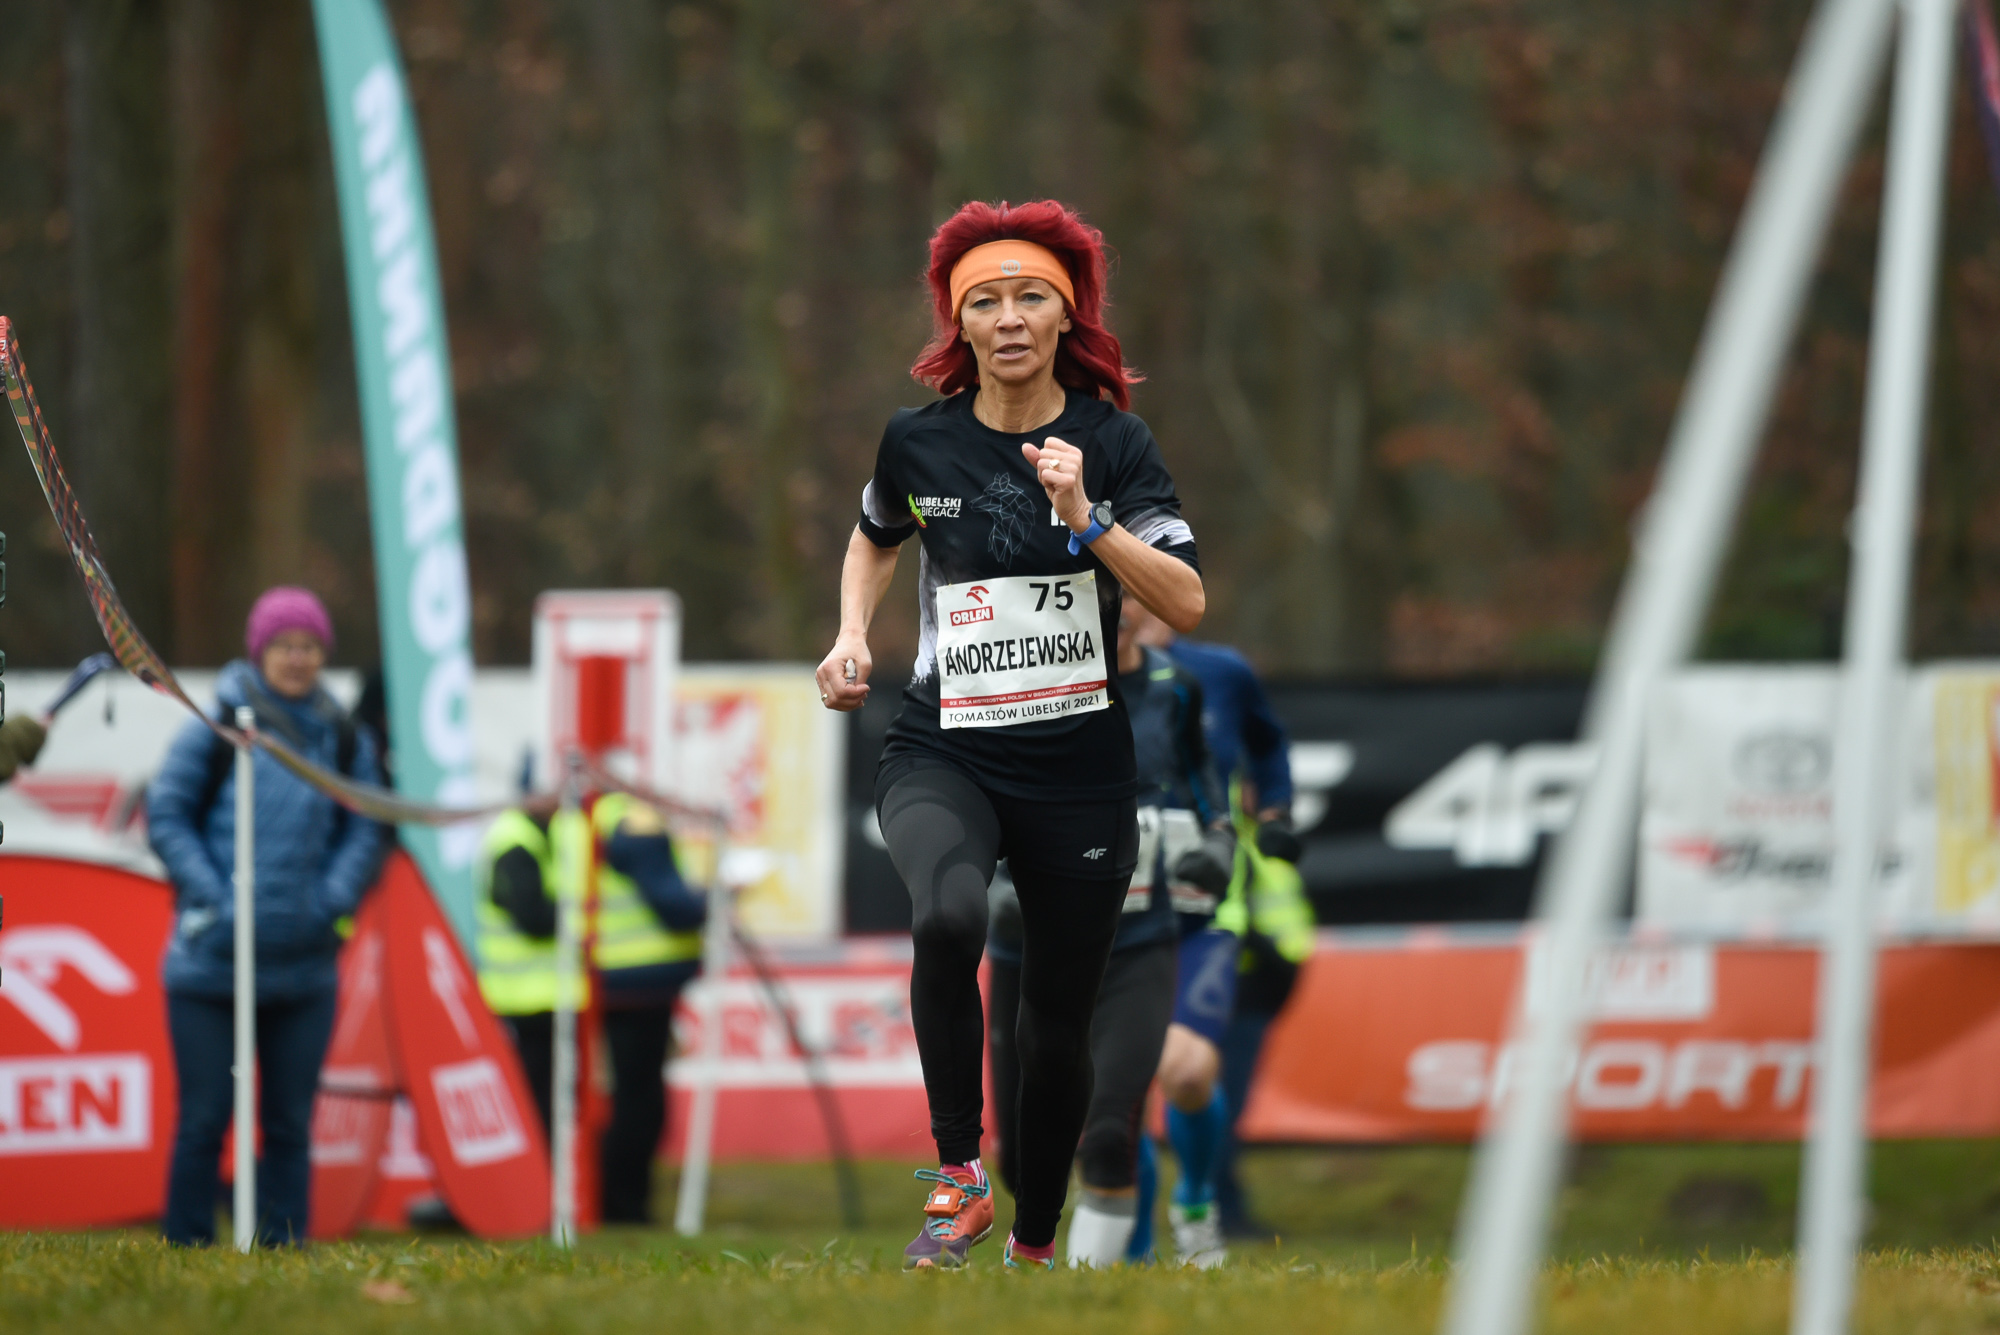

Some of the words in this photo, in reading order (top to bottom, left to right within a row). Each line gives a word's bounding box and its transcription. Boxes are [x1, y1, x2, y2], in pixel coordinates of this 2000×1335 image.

[915, 496, 962, 508] LUBELSKI
[921, 507, 960, 518] BIEGACZ
[1029, 580, 1075, 612] 75
[952, 608, 991, 625] ORLEN
[945, 630, 1096, 677] ANDRZEJEWSKA
[1008, 694, 1027, 702] POLSKI
[949, 707, 1018, 723] TOMASZÓW
[1022, 700, 1071, 718] LUBELSKI
[1074, 694, 1100, 709] 2021
[1083, 848, 1107, 860] 4F
